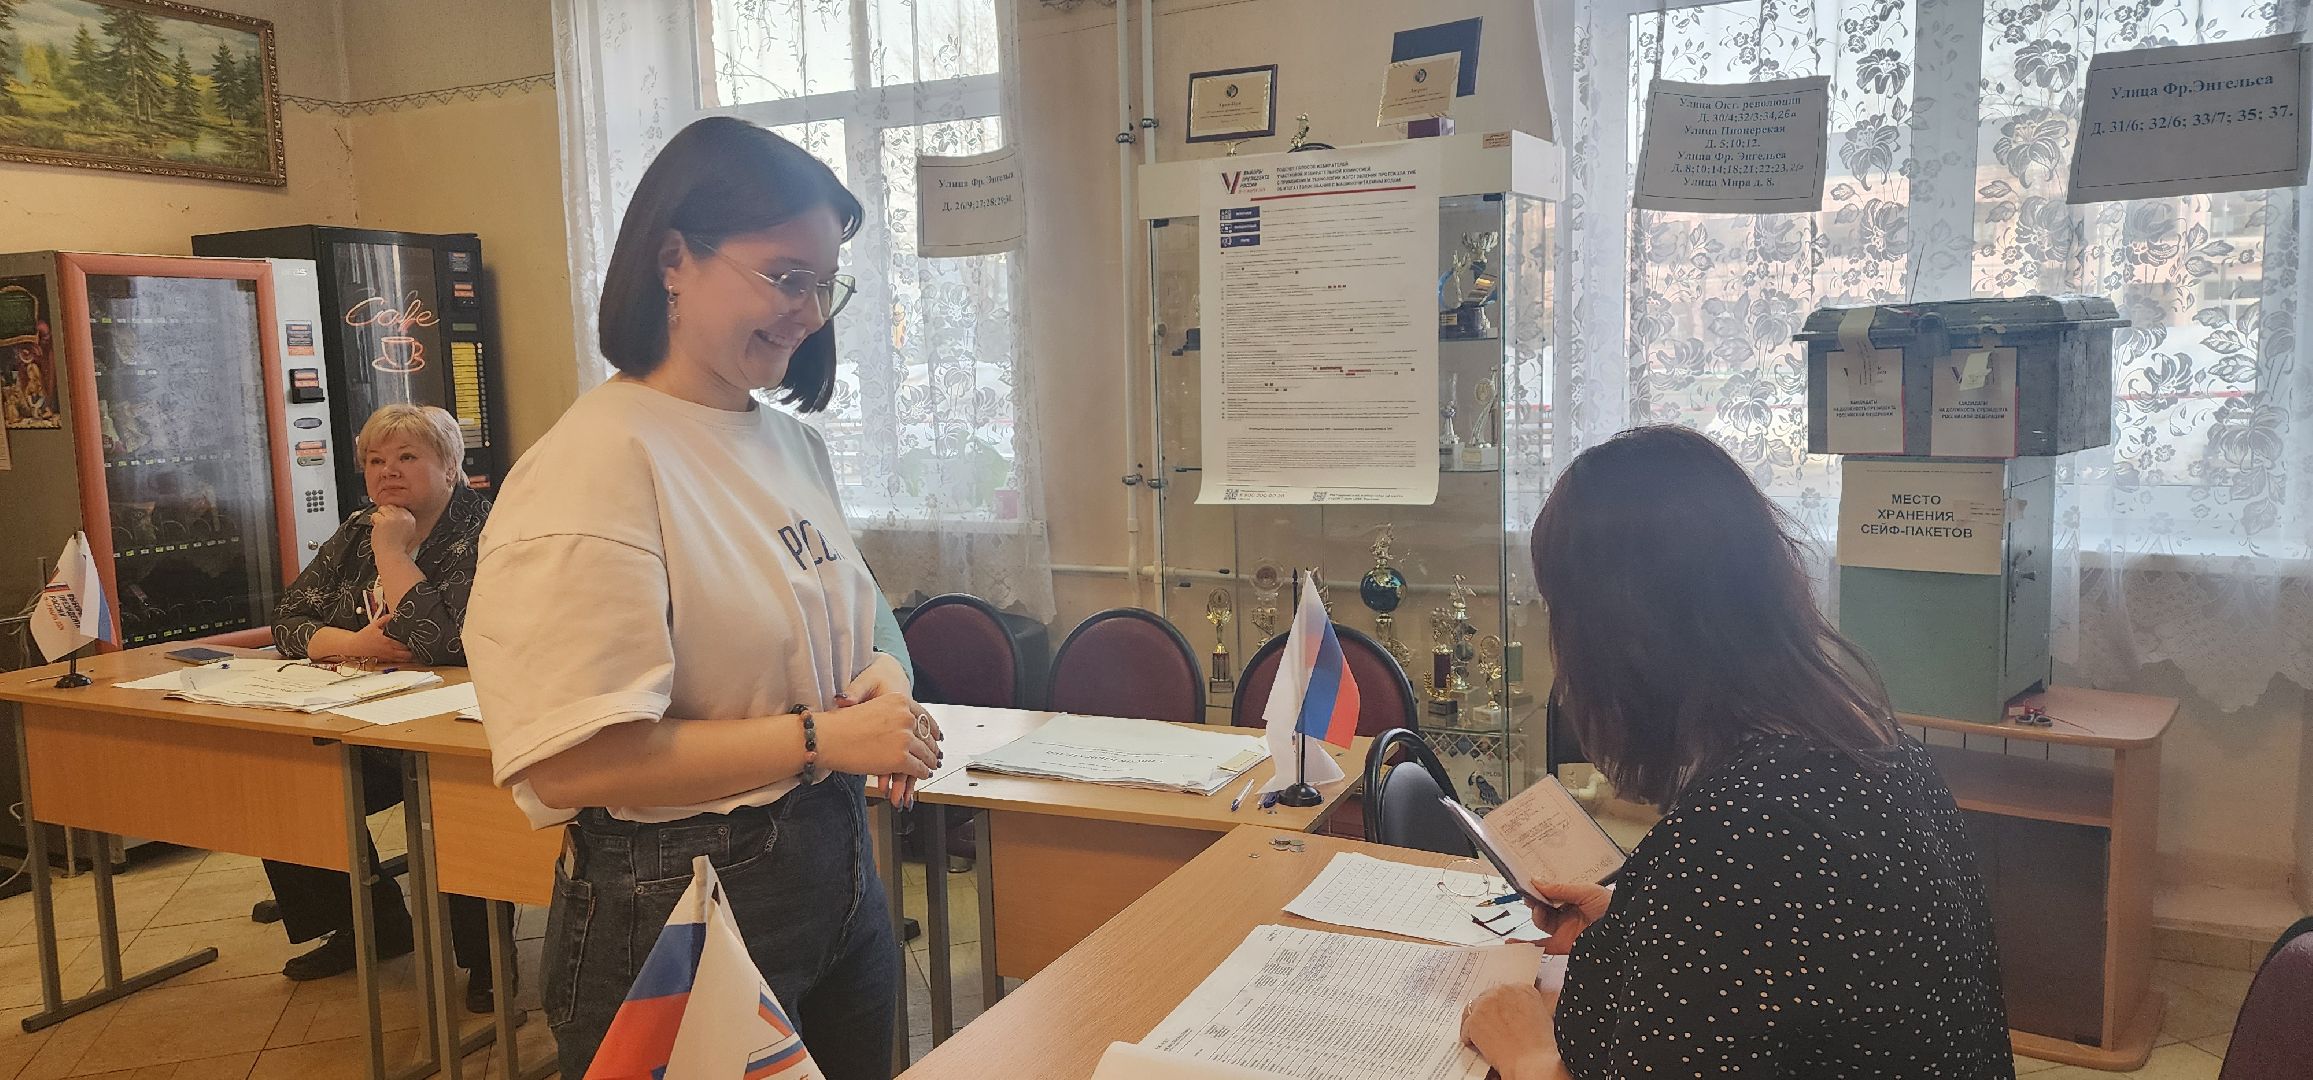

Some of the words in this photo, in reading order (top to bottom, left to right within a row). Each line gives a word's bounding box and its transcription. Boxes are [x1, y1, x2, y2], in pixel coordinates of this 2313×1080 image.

[2111, 86, 2158, 100] Улица
[2163, 75, 2274, 97] Фр.Энгельса
[1680, 97, 1711, 110] Улица
[1743, 97, 1801, 111] революции
[2090, 122, 2105, 137] Д.
[2109, 120, 2144, 134] 31/6;
[2149, 115, 2187, 130] 32/6;
[2192, 111, 2231, 127] 33/7;
[2237, 107, 2263, 122] 35;
[2268, 104, 2294, 119] 37.
[1684, 125, 1716, 136] Улица
[1721, 125, 1785, 136] Пионерская
[1678, 151, 1711, 161] Улица
[1738, 151, 1786, 161] Энгельса
[1683, 177, 1716, 187] Улица
[1721, 178, 1750, 188] Мира
[346, 296, 440, 332] Cafe
[1891, 493, 1941, 505] МЕСТО
[1877, 508, 1955, 522] ХРАНЕНИЯ
[1860, 522, 1973, 539] СЕЙФ-ПАКЕТОВ
